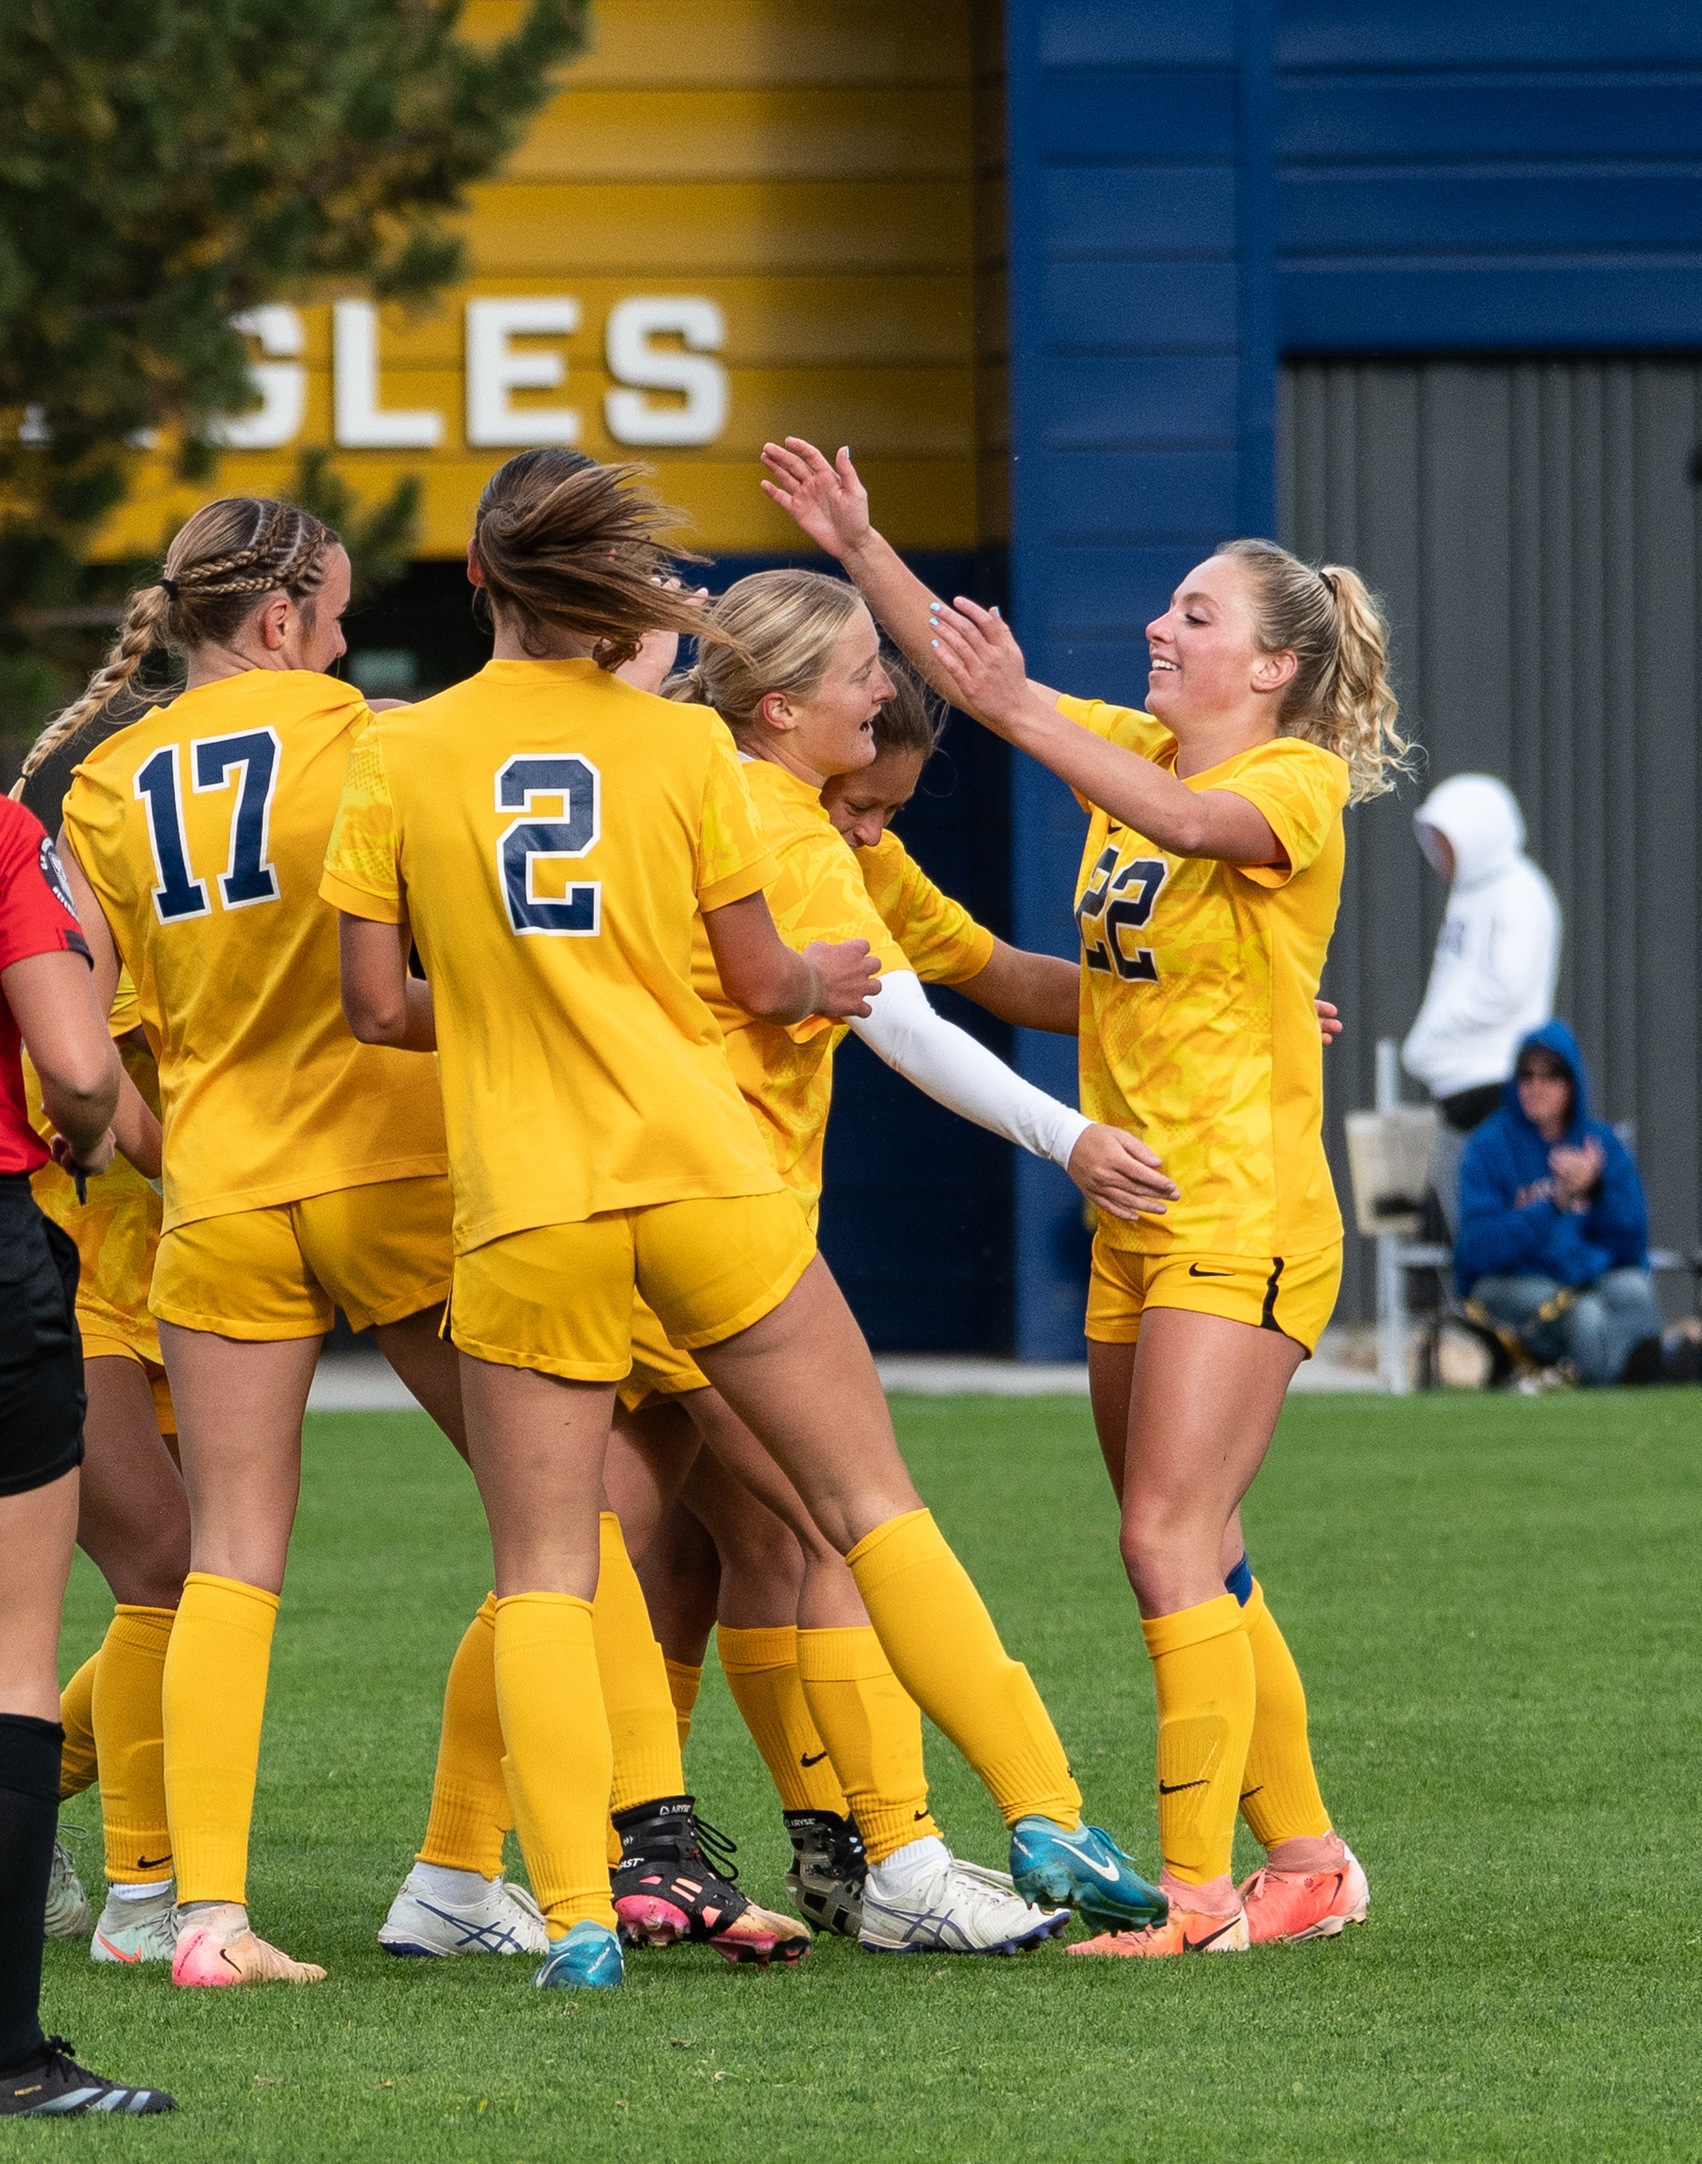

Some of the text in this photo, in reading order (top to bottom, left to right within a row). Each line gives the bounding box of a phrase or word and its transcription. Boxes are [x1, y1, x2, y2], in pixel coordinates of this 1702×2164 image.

[20, 296, 728, 449] GLES
[132, 725, 283, 925] 17
[494, 753, 602, 936] 2
[1074, 844, 1169, 984] 22
